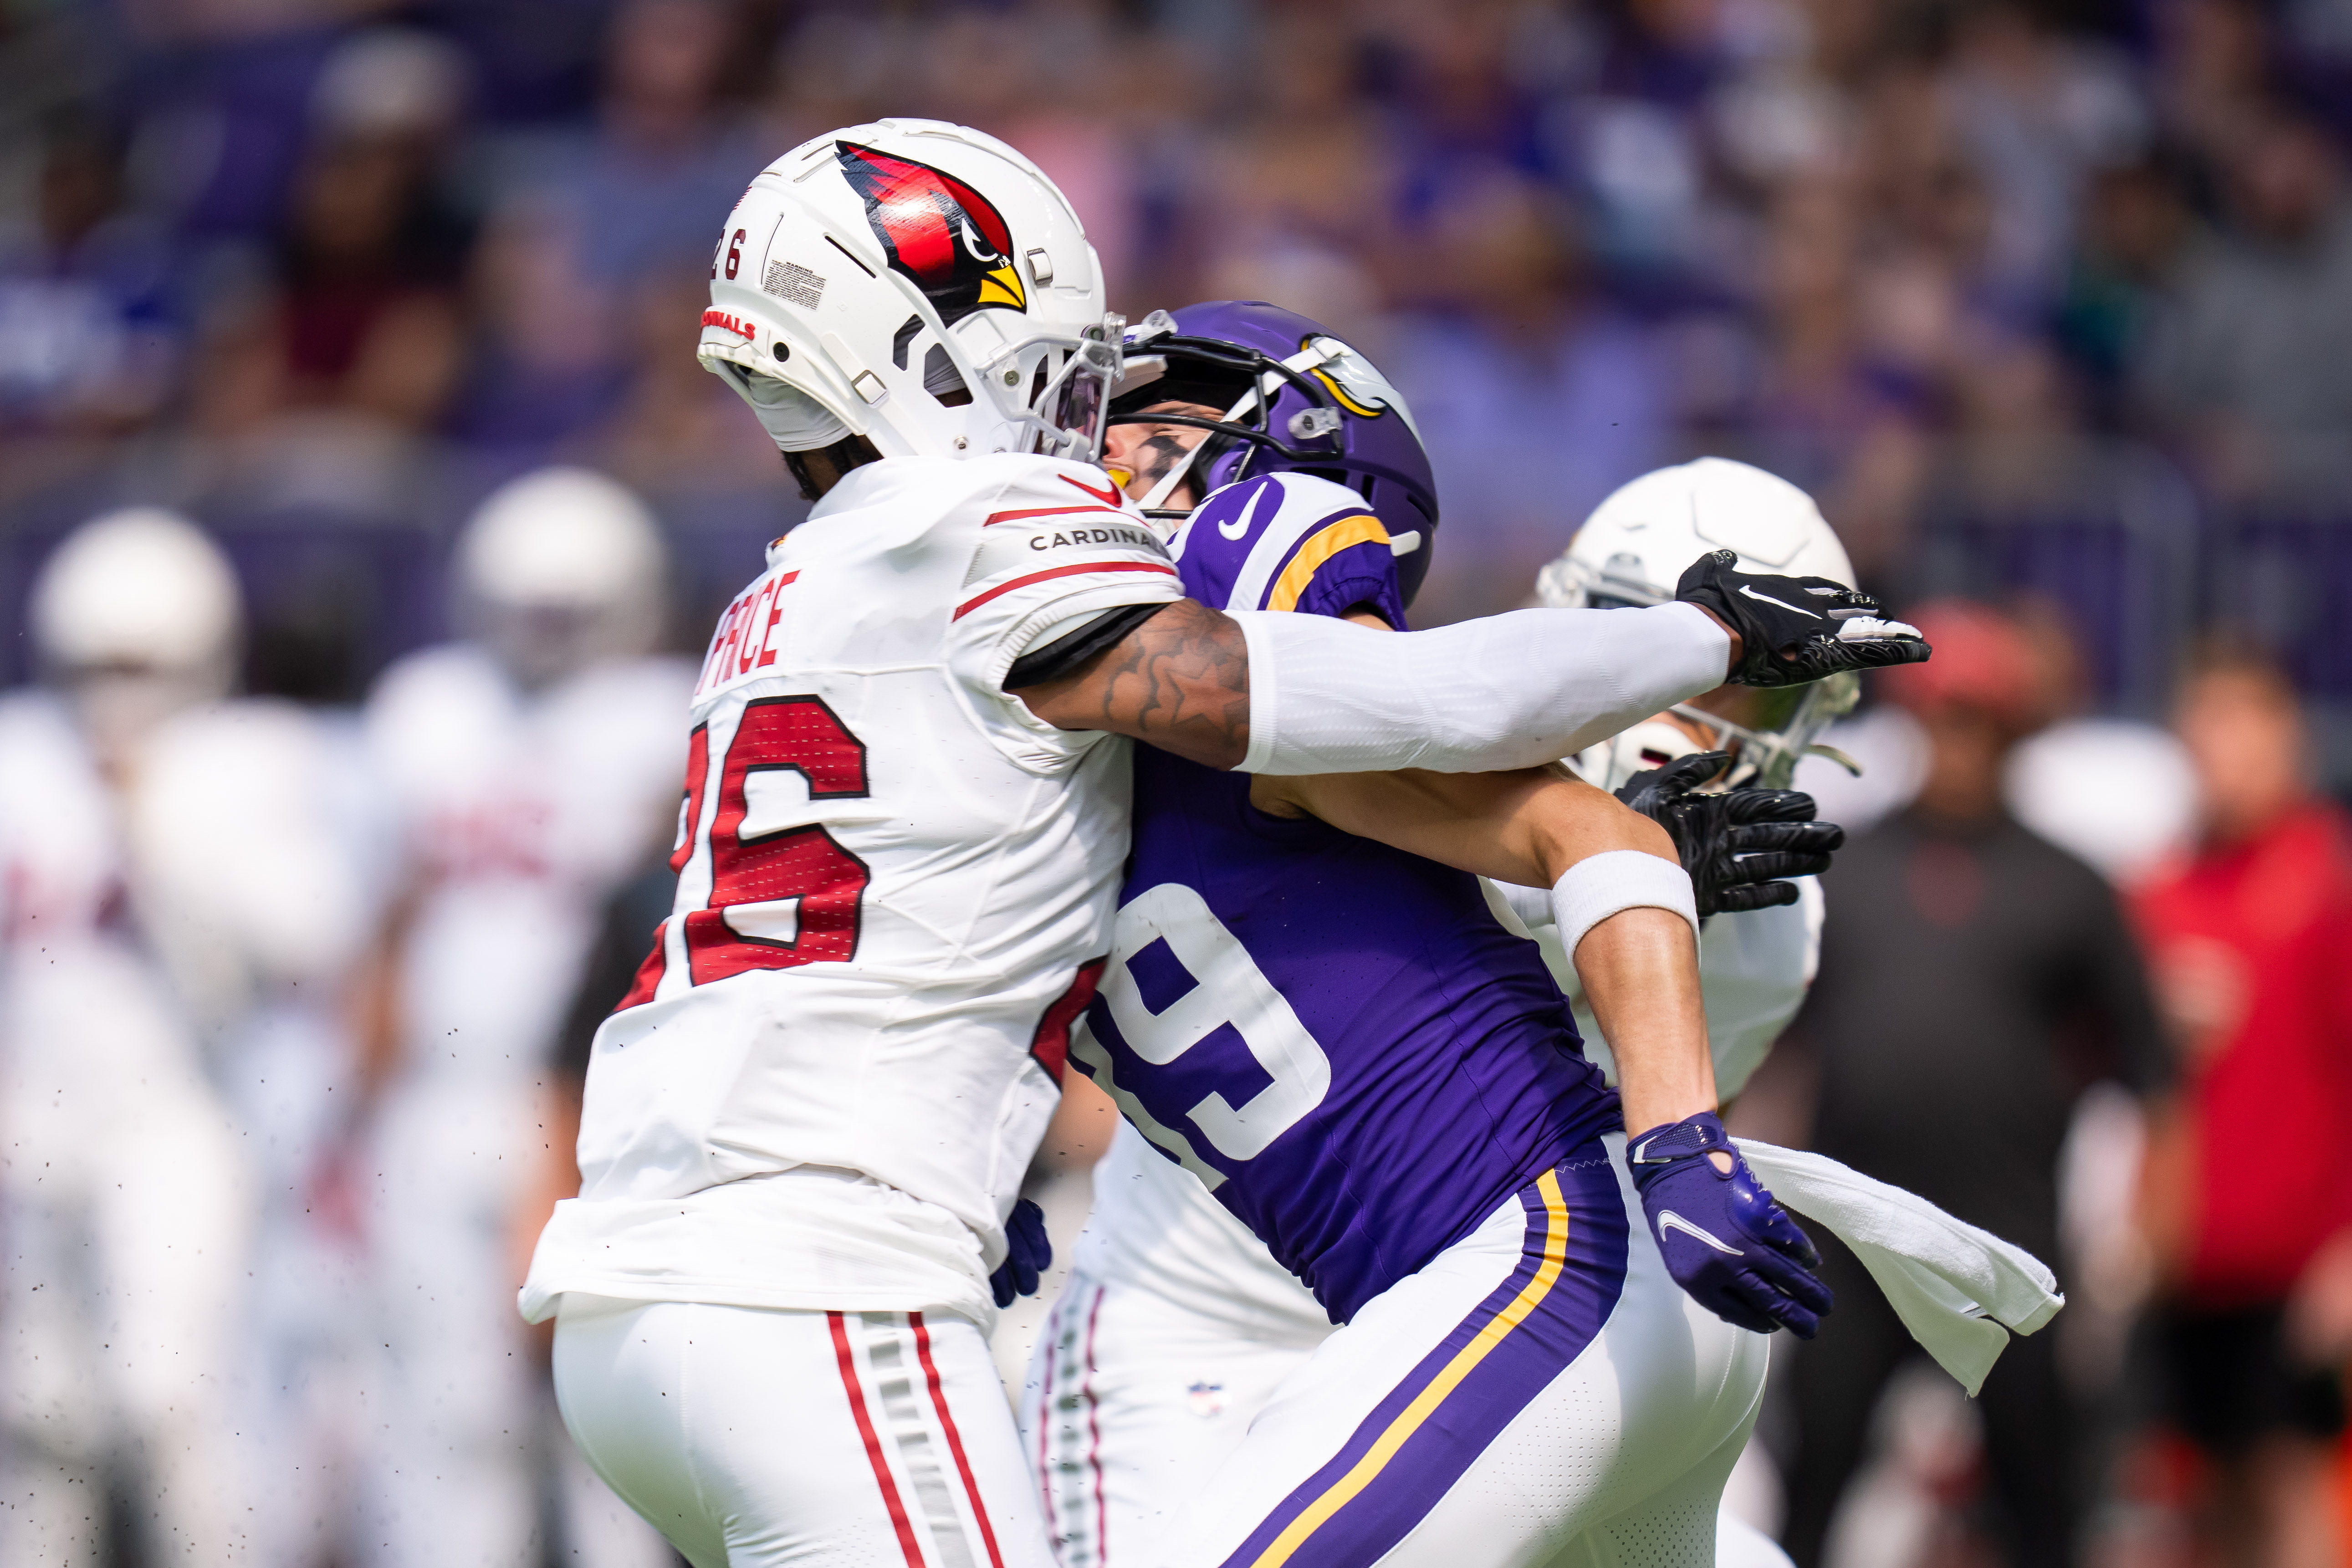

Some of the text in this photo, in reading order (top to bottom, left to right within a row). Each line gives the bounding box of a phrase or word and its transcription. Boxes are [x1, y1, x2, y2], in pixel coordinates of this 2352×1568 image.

[786, 261, 813, 274] WARNING
[1029, 529, 1155, 551] CARDINA
[1069, 883, 1331, 1194] 19
